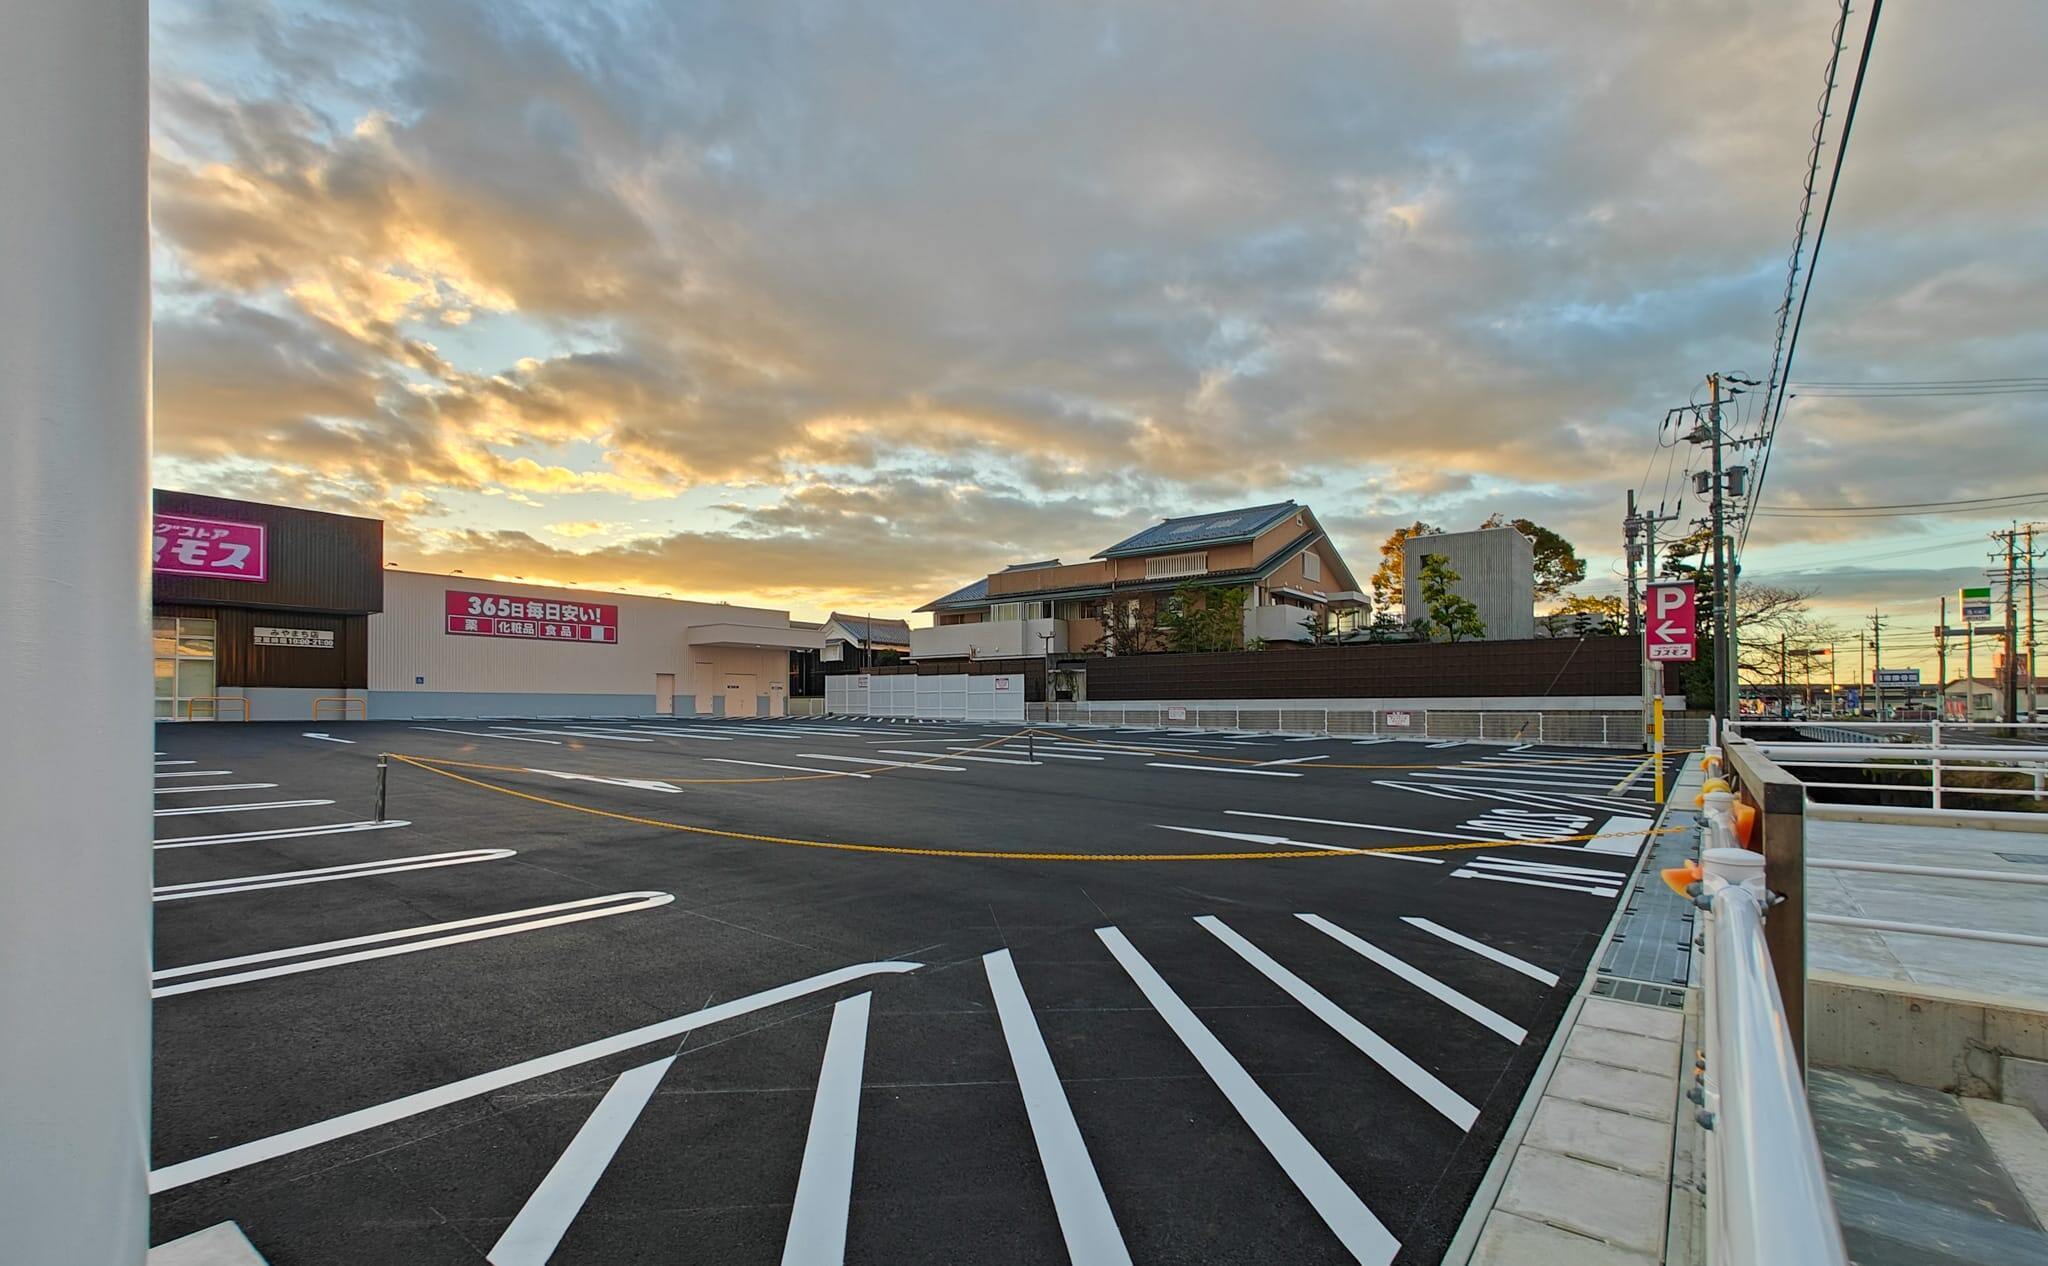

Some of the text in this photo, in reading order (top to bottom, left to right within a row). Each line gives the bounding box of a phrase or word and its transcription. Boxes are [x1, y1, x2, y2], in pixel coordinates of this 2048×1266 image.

[1656, 586, 1687, 620] P
[464, 619, 478, 632] 薬
[498, 622, 535, 635] 化粧品
[1450, 855, 1627, 898] IN
